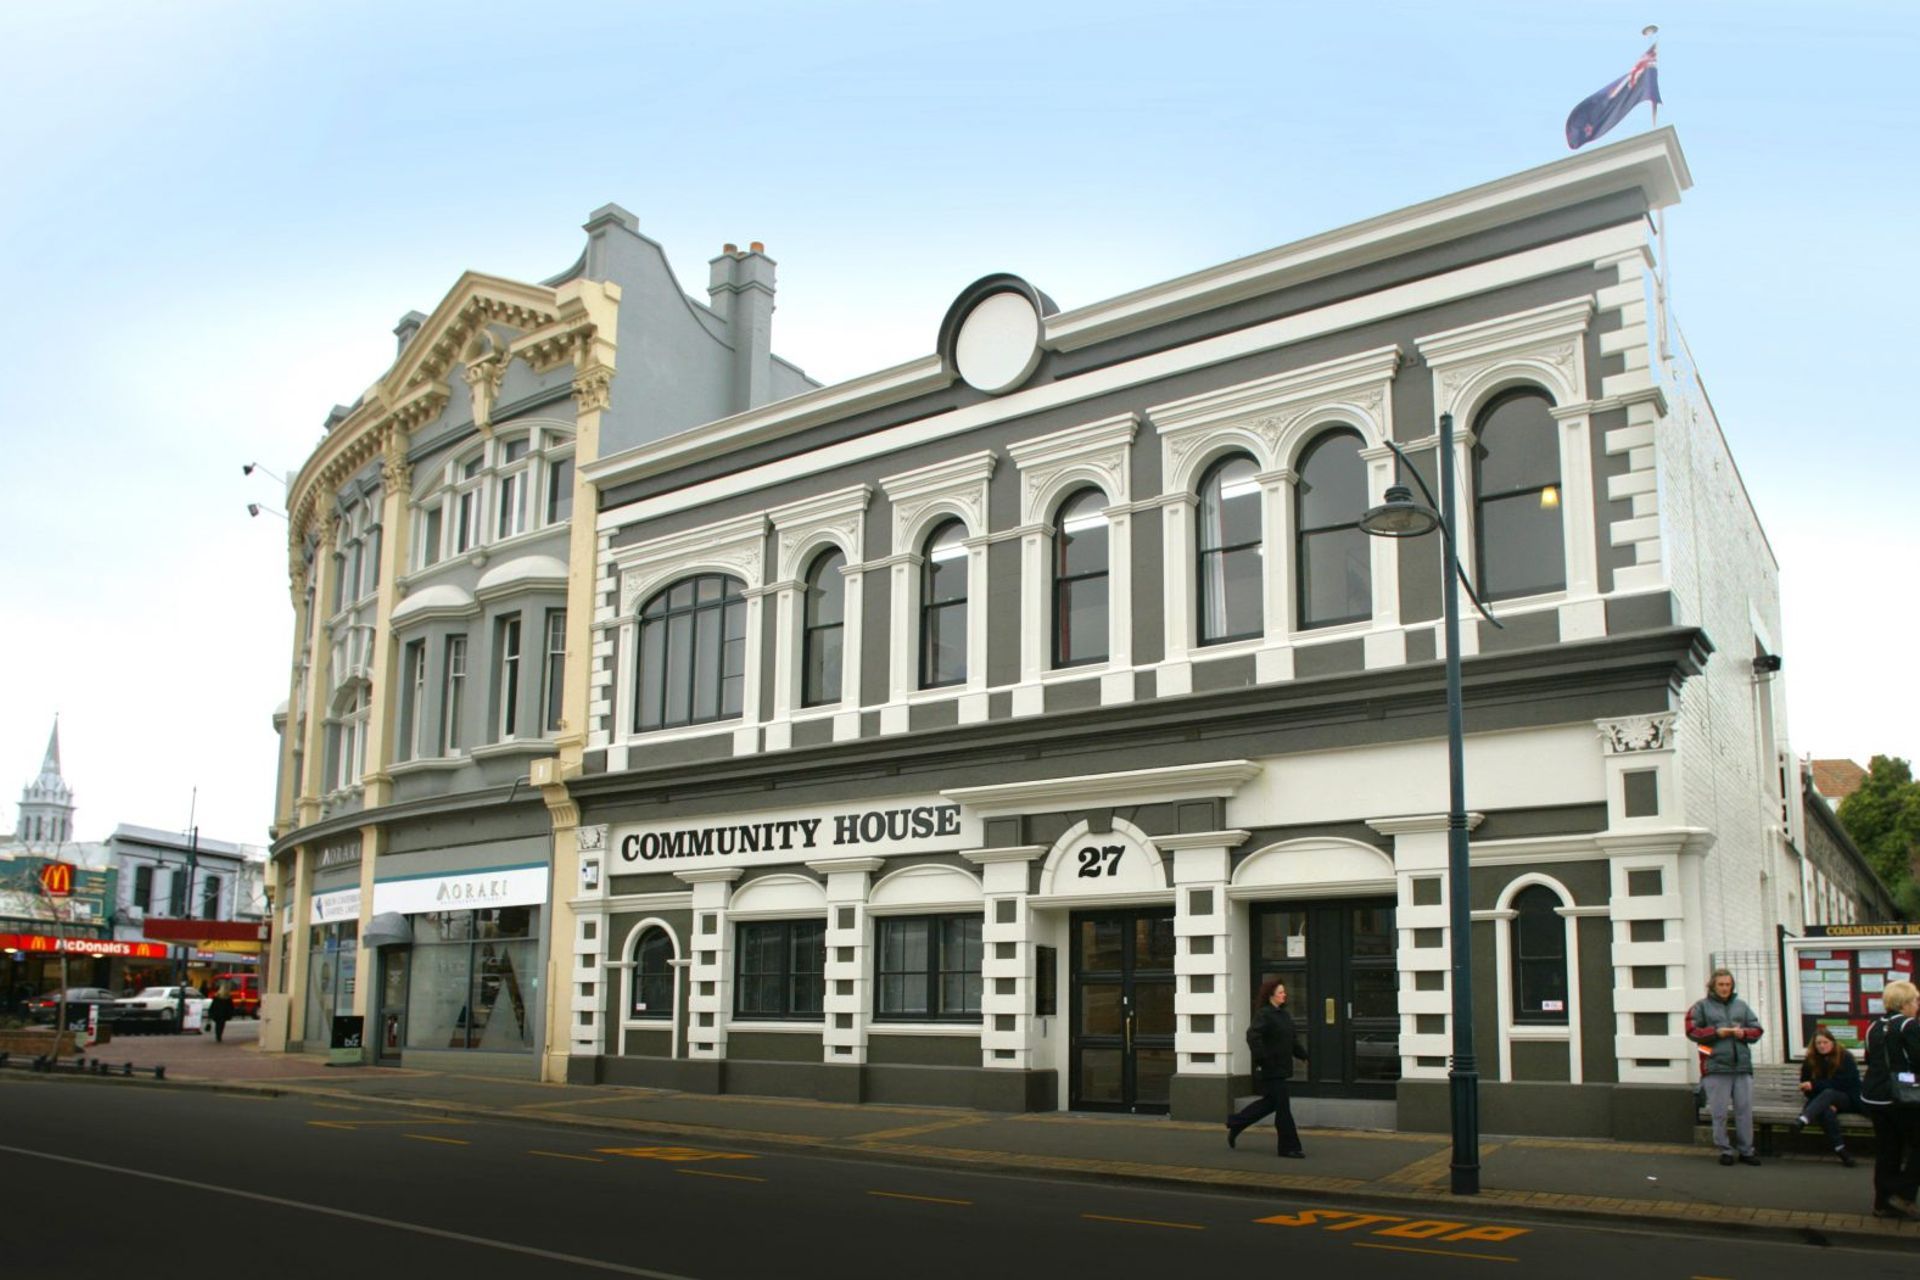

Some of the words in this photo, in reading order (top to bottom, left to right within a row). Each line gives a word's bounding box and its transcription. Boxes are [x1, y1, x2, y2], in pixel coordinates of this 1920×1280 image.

[621, 818, 822, 862] COMMUNITY
[833, 803, 962, 846] HOUSE
[1078, 845, 1126, 878] 27
[436, 879, 508, 901] AORAKI
[1826, 924, 1904, 936] COMMUNITY
[55, 938, 131, 955] McDonald's
[1252, 1209, 1534, 1242] STOP
